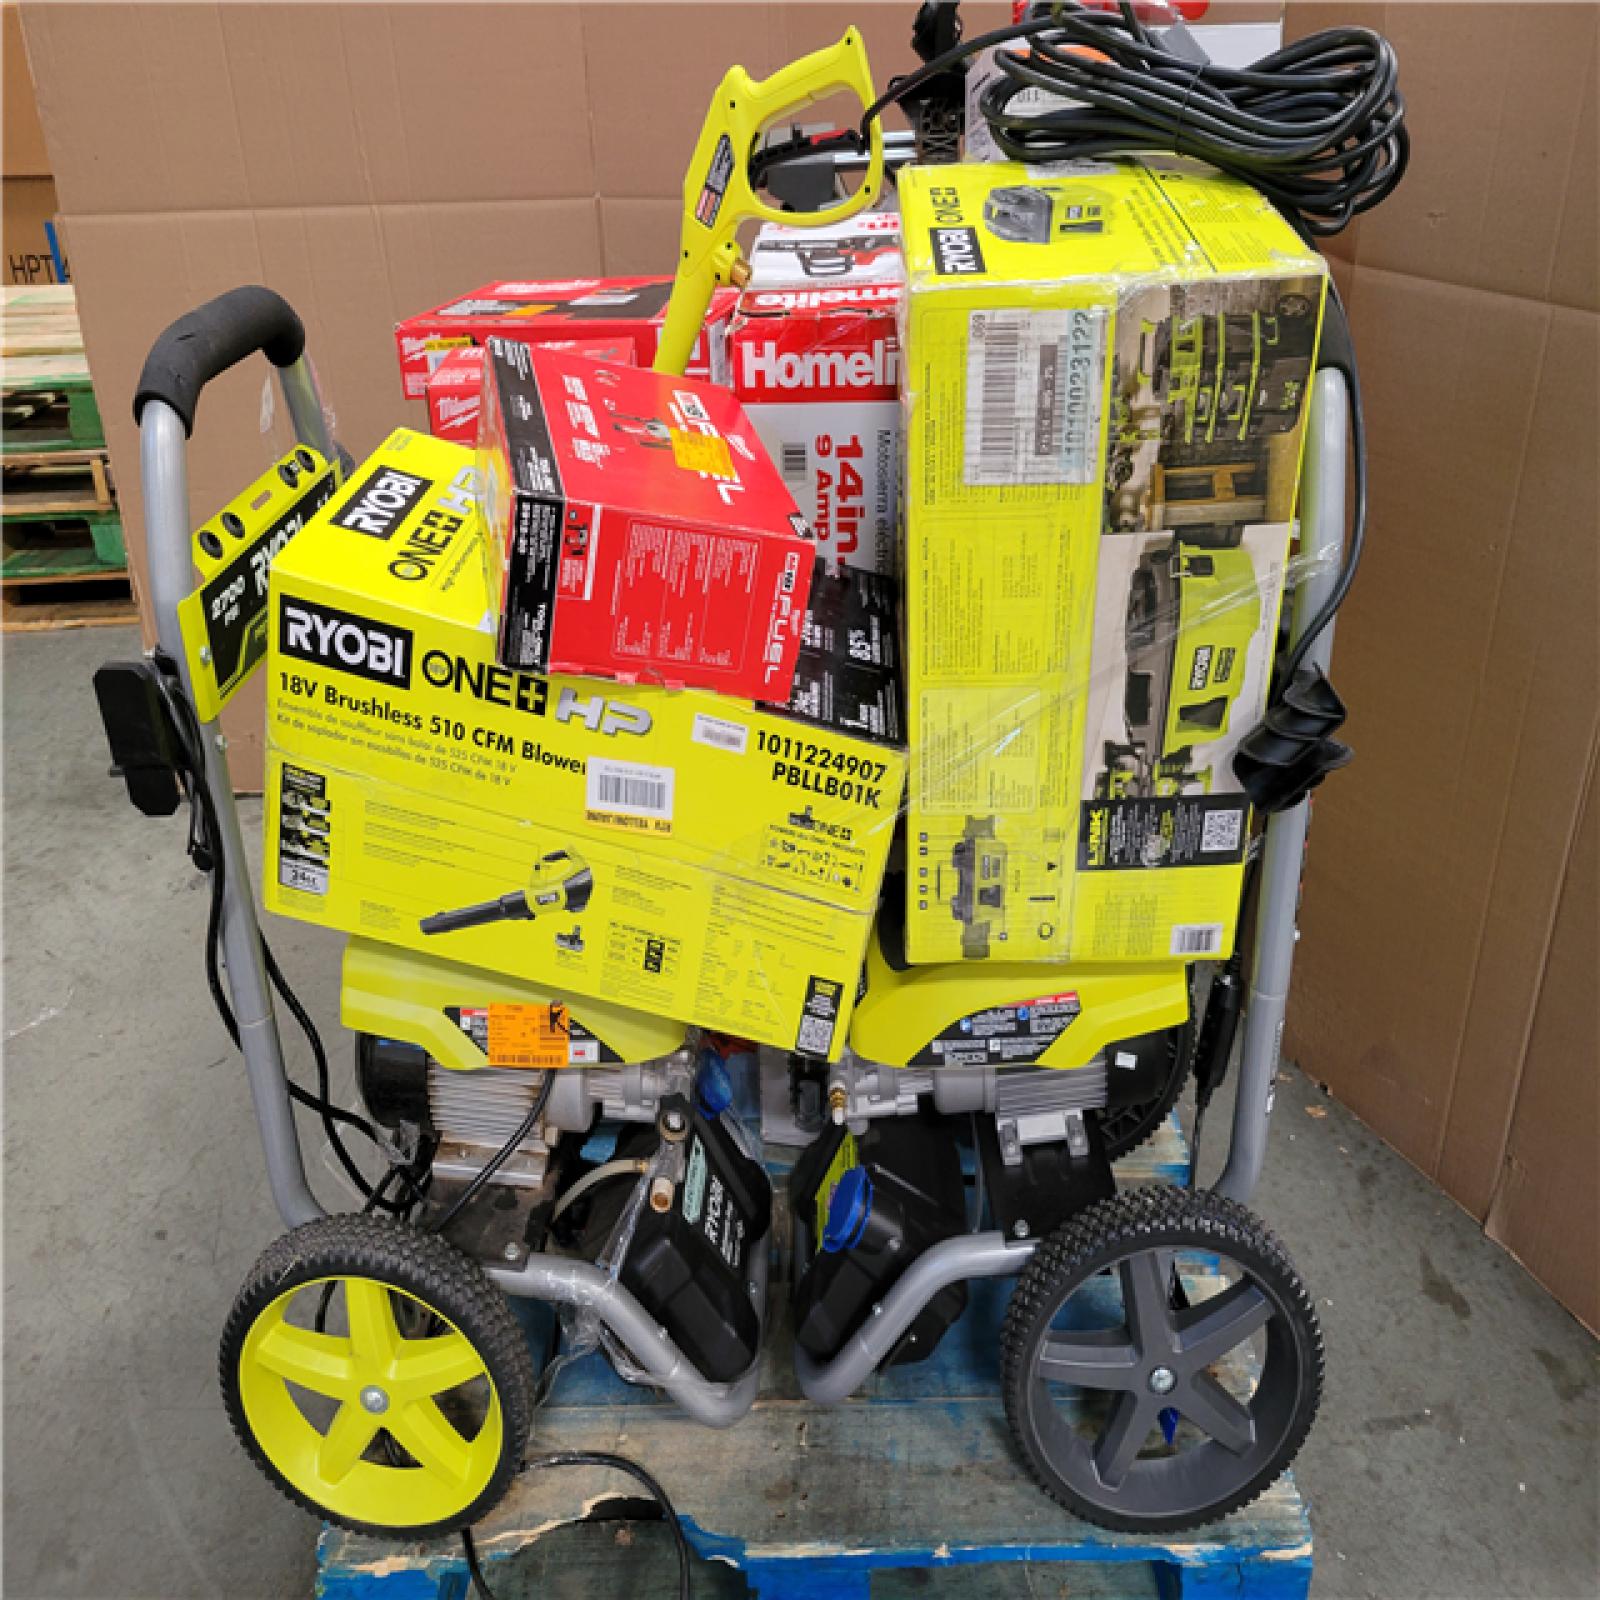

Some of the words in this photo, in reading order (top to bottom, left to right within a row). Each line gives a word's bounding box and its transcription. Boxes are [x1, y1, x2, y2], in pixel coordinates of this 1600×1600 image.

[814, 433, 833, 458] 9
[341, 471, 423, 535] RYOBI
[813, 469, 834, 542] Amp
[284, 606, 405, 678] RYOBI
[554, 686, 653, 737] HP
[279, 673, 318, 698] 18V
[324, 685, 423, 731] Brushless
[429, 715, 466, 741] 510
[472, 727, 514, 756] CFM
[756, 729, 888, 784] 1011224907
[771, 761, 881, 809] PBLLB01K
